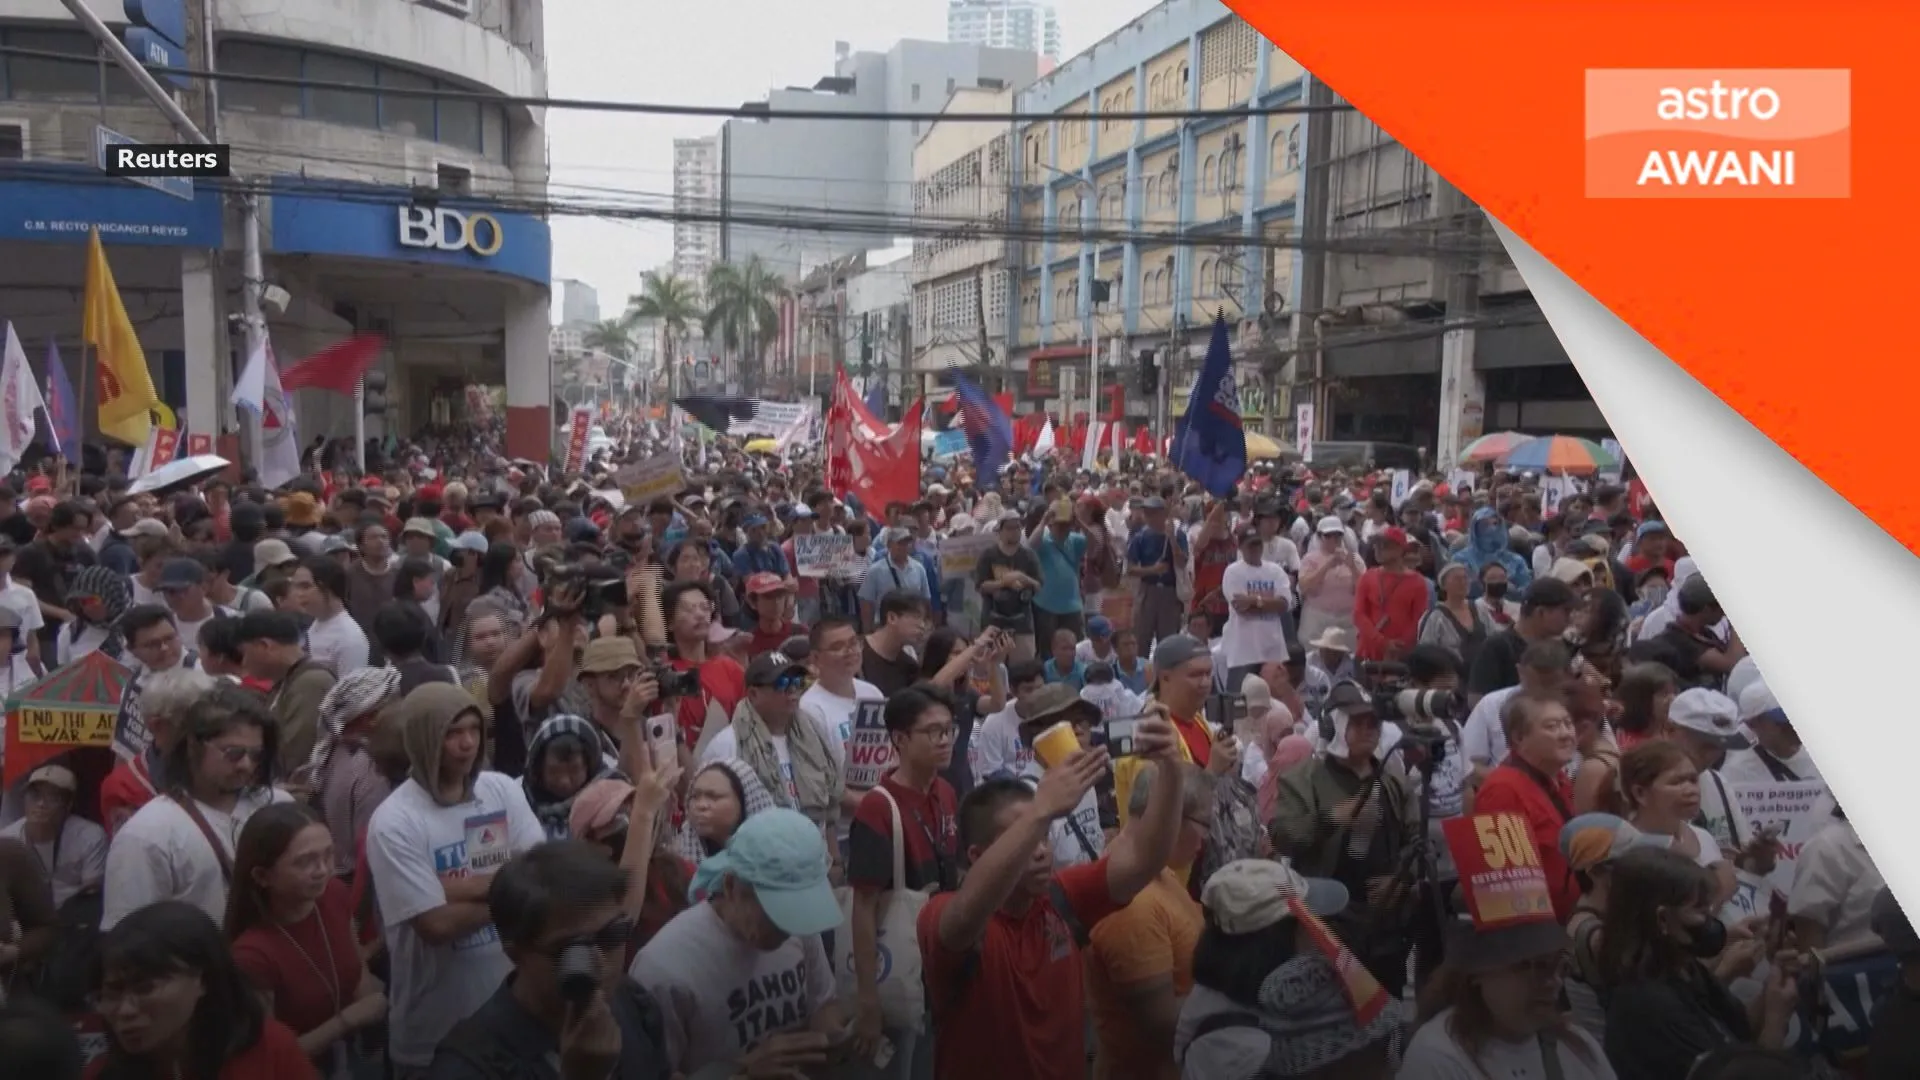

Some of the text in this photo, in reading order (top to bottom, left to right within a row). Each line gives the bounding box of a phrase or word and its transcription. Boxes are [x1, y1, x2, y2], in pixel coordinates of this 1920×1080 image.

[150, 41, 169, 67] ATM
[50, 220, 89, 232] RECTO
[151, 224, 188, 237] REYES
[399, 205, 503, 256] BDO
[38, 727, 81, 742] WAR
[855, 731, 881, 744] PASS
